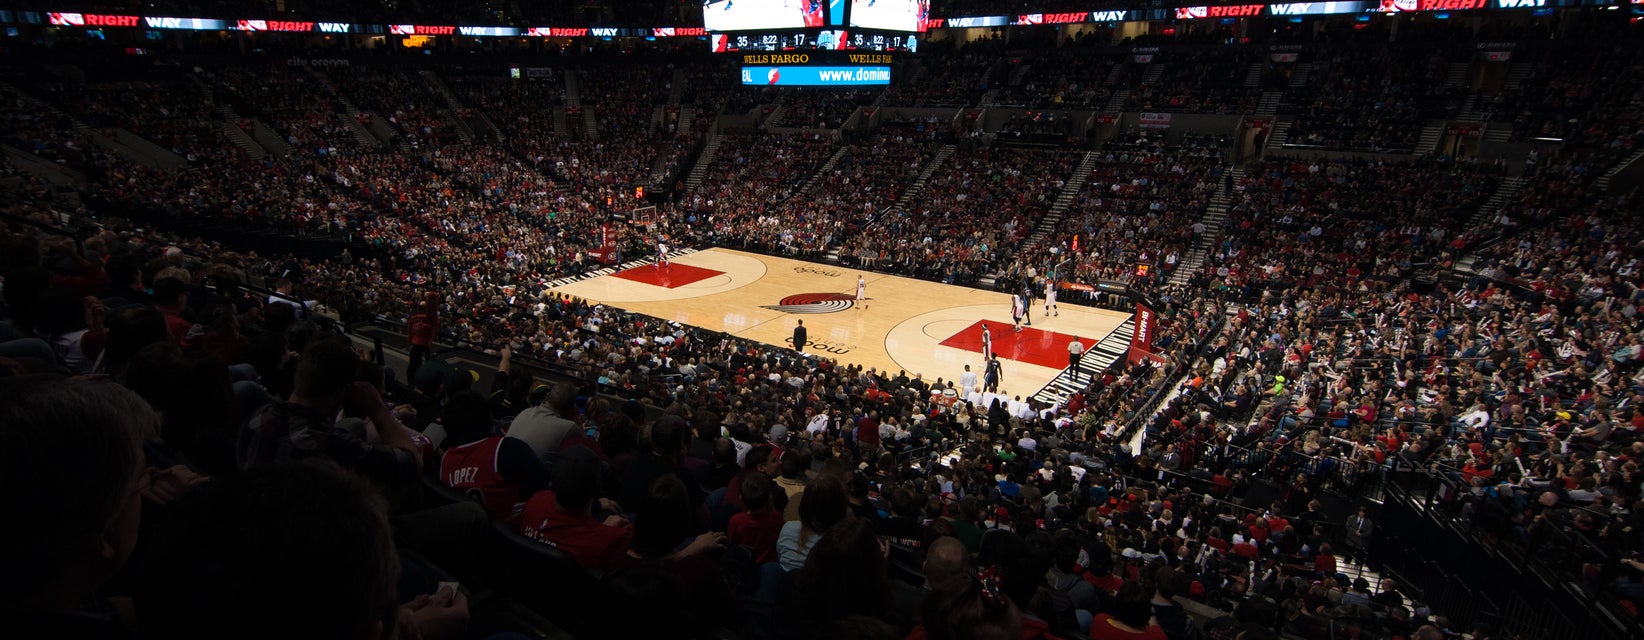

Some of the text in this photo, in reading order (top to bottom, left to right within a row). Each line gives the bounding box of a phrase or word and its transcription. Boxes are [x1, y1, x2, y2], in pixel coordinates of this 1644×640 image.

[1210, 3, 1312, 17] RIGHT WAY
[84, 14, 181, 29] RIGHT WAY
[948, 17, 976, 28] WAY
[1044, 11, 1127, 24] RIGHT WAY
[267, 21, 350, 33] RIGHT WAY
[414, 25, 487, 36] RIGHT WAY
[551, 28, 618, 37] RIGHT WAY
[675, 28, 708, 36] RIGH
[737, 36, 748, 47] 35
[762, 35, 777, 44] 8:22
[794, 34, 805, 46] 17
[855, 34, 864, 46] 35
[893, 36, 901, 47] 17
[743, 53, 809, 64] WELLS FARGO
[849, 54, 881, 64] WELLS
[1138, 310, 1149, 343] BI-MART
[449, 467, 479, 488] LOPEZ
